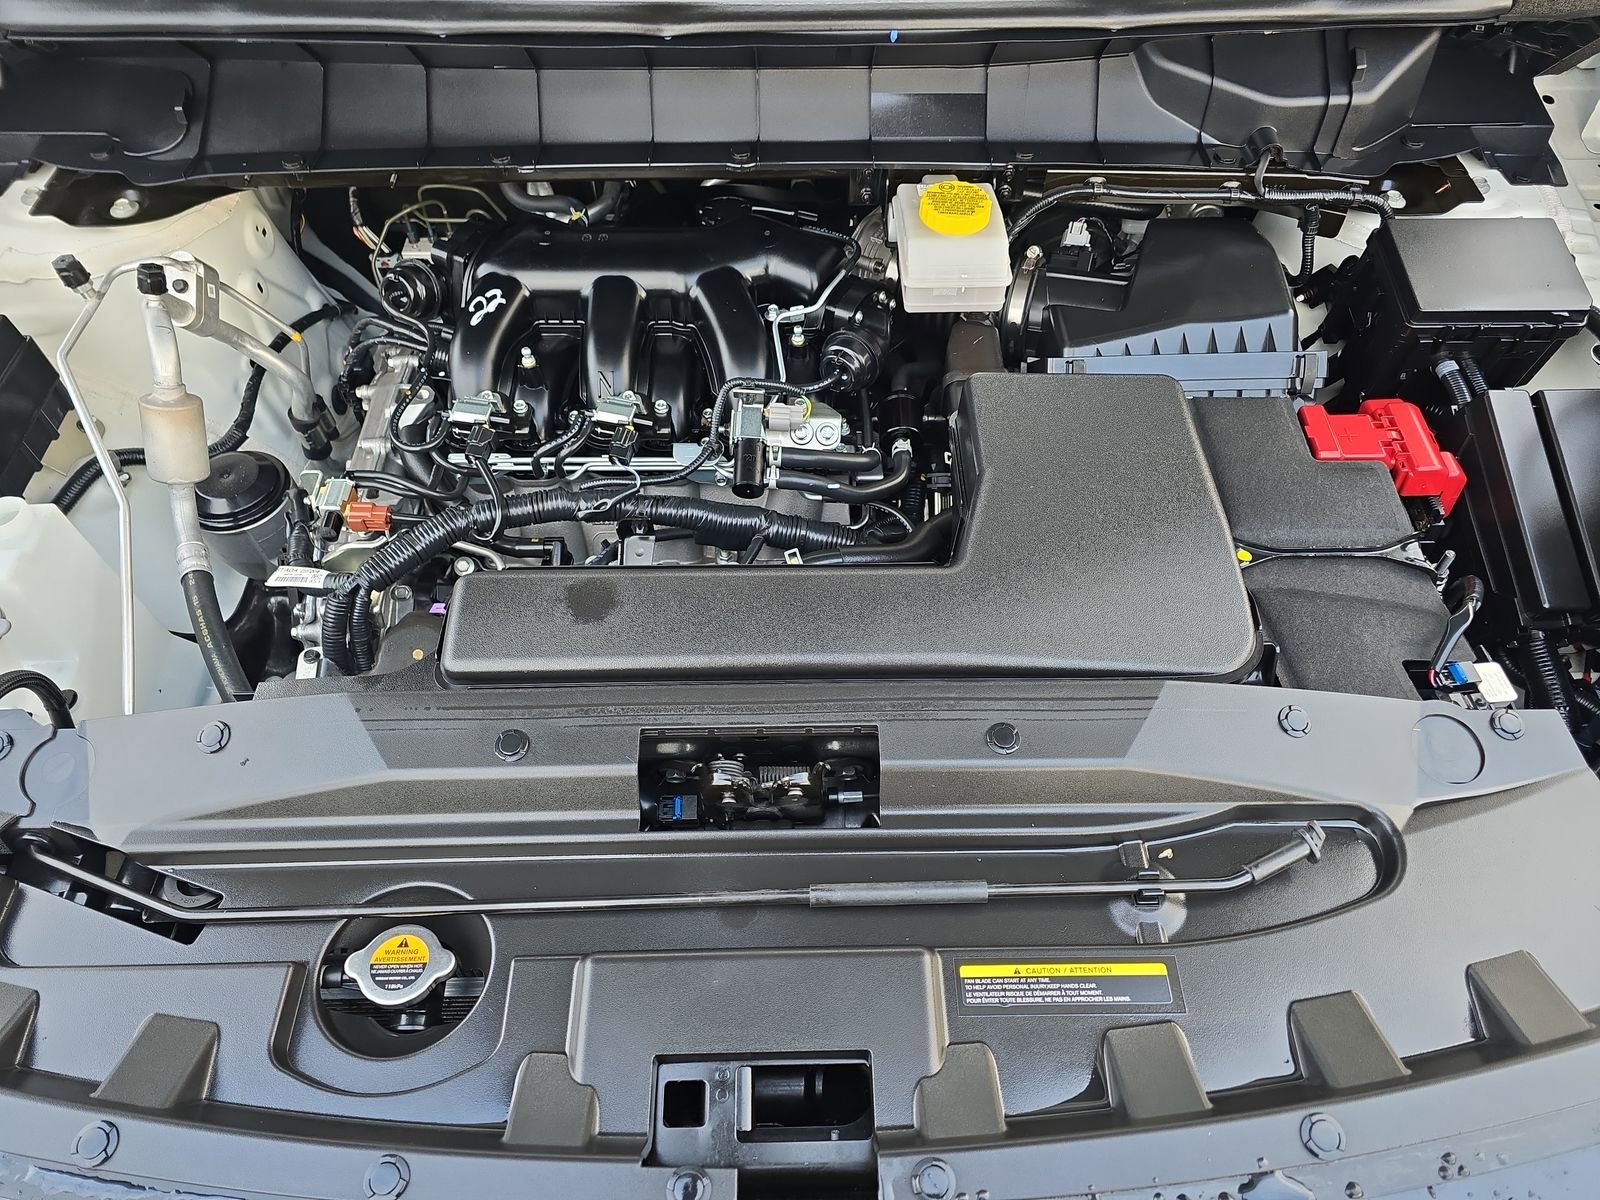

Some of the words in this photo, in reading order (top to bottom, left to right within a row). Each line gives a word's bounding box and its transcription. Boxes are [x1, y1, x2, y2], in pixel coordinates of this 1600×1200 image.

[469, 288, 507, 326] 22
[1025, 967, 1061, 975] CAUTION
[1069, 966, 1113, 974] ATTENTION
